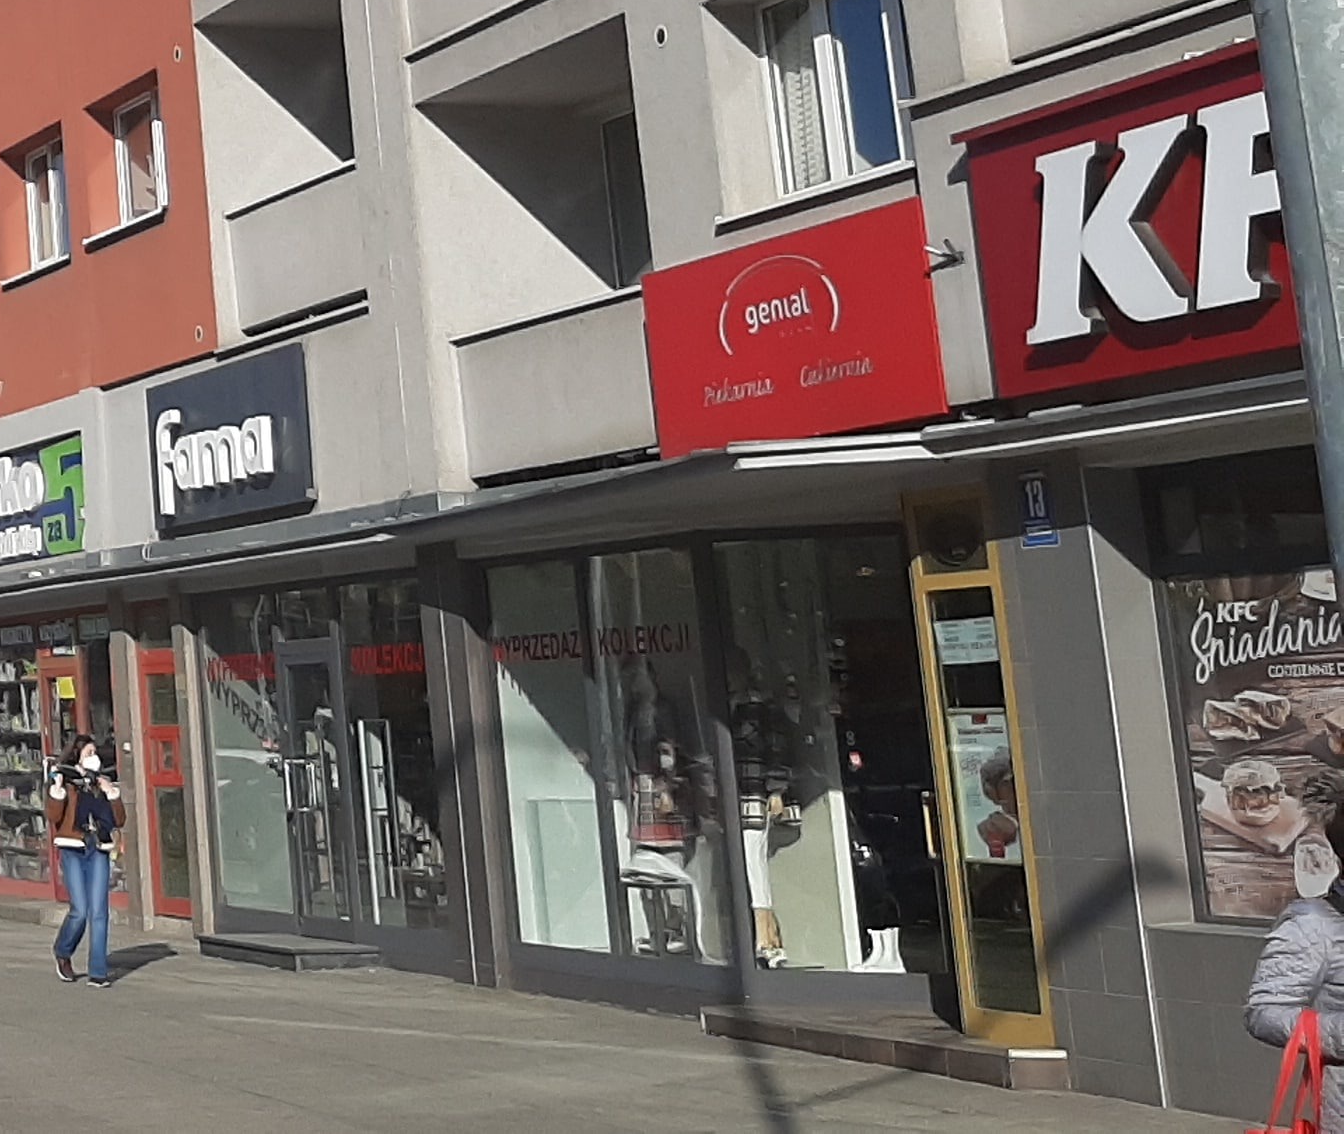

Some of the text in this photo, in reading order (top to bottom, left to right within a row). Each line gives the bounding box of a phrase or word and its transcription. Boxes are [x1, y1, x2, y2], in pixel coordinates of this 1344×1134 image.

[1026, 91, 1281, 345] KF
[744, 286, 811, 334] genial
[155, 408, 274, 515] fama
[48, 520, 62, 542] za
[1216, 600, 1259, 623] KFC
